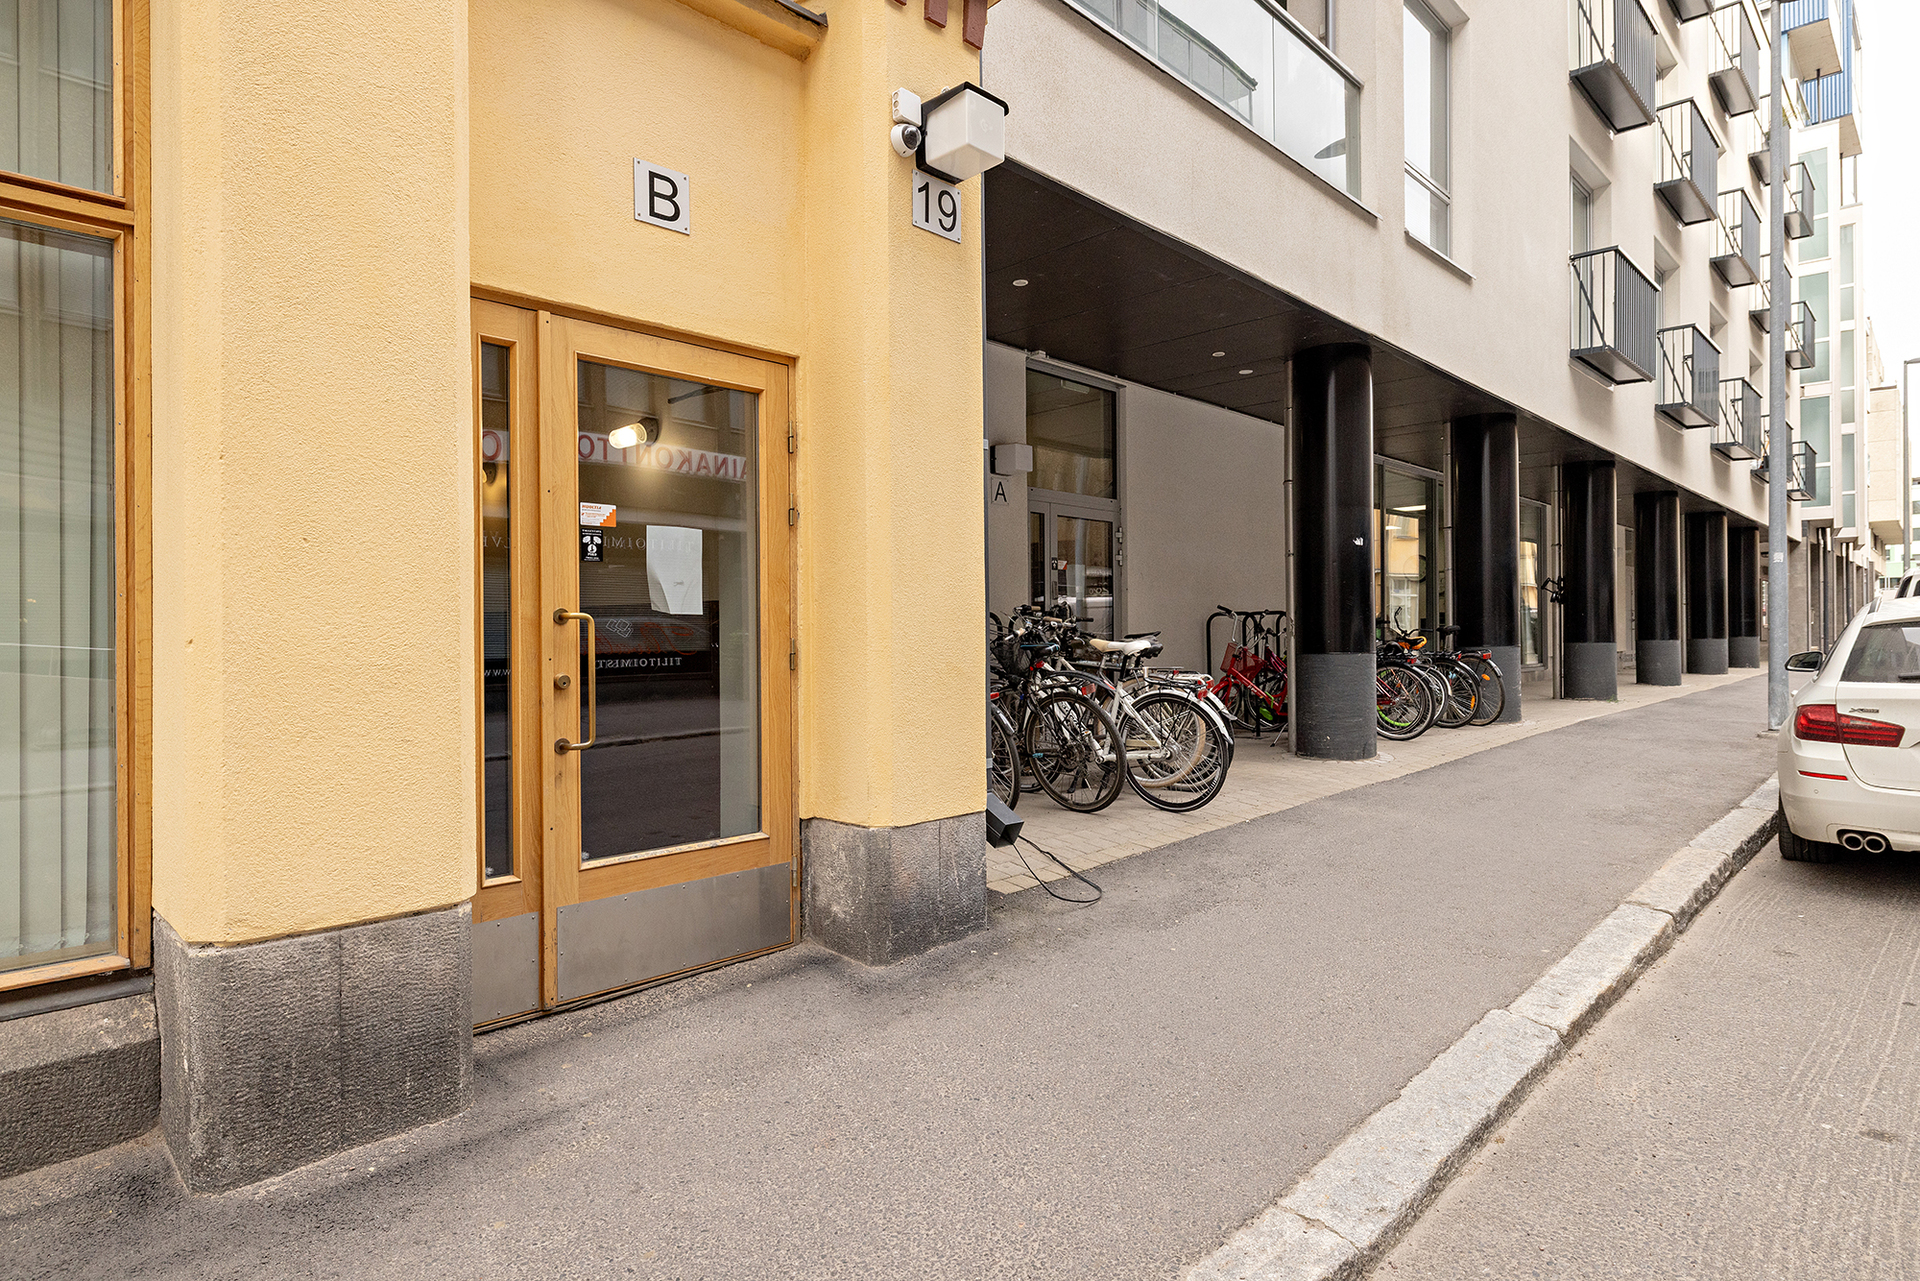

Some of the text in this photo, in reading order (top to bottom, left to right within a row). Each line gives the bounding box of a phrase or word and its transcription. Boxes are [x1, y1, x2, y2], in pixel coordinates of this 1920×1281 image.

[648, 170, 681, 222] B
[917, 181, 958, 233] 19
[994, 481, 1007, 502] A
